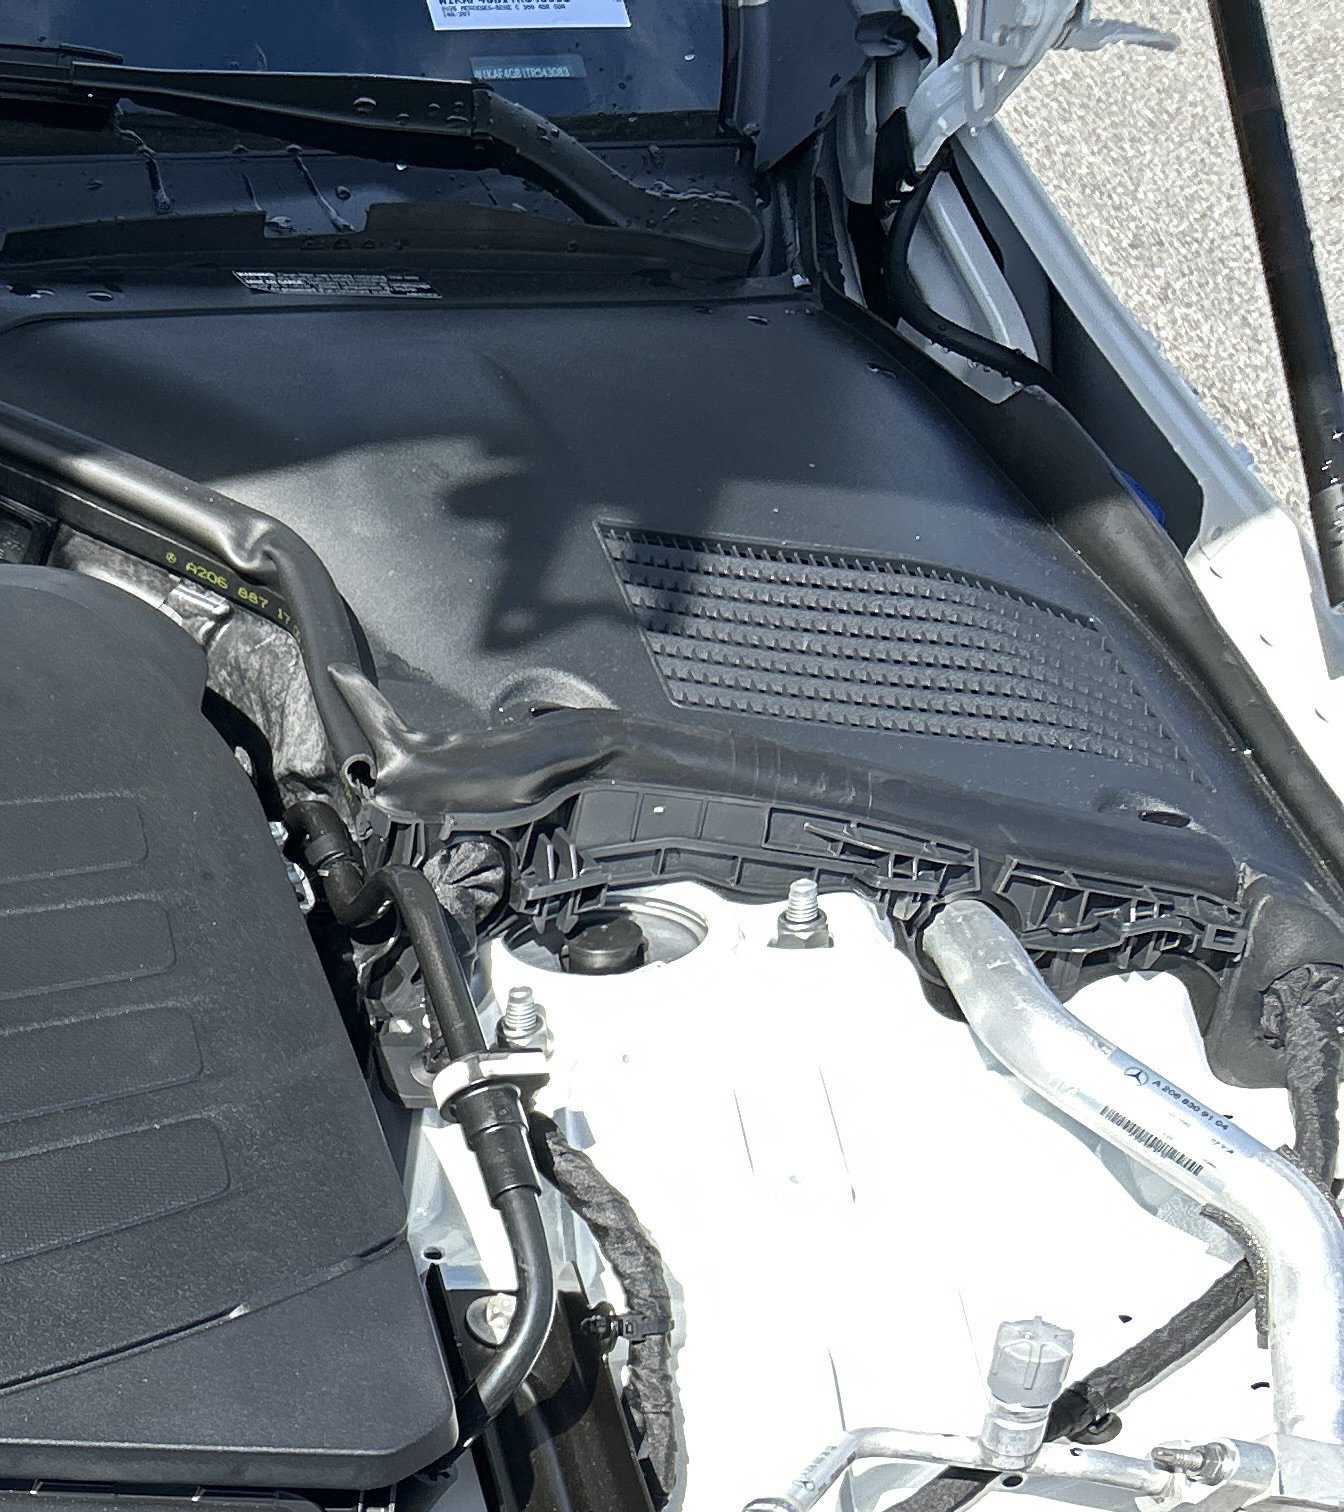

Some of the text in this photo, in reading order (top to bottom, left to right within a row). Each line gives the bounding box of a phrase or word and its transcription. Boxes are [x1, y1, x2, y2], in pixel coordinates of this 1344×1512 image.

[186, 562, 228, 589] A206
[238, 586, 269, 608] 887
[1152, 1080, 1161, 1088] A
